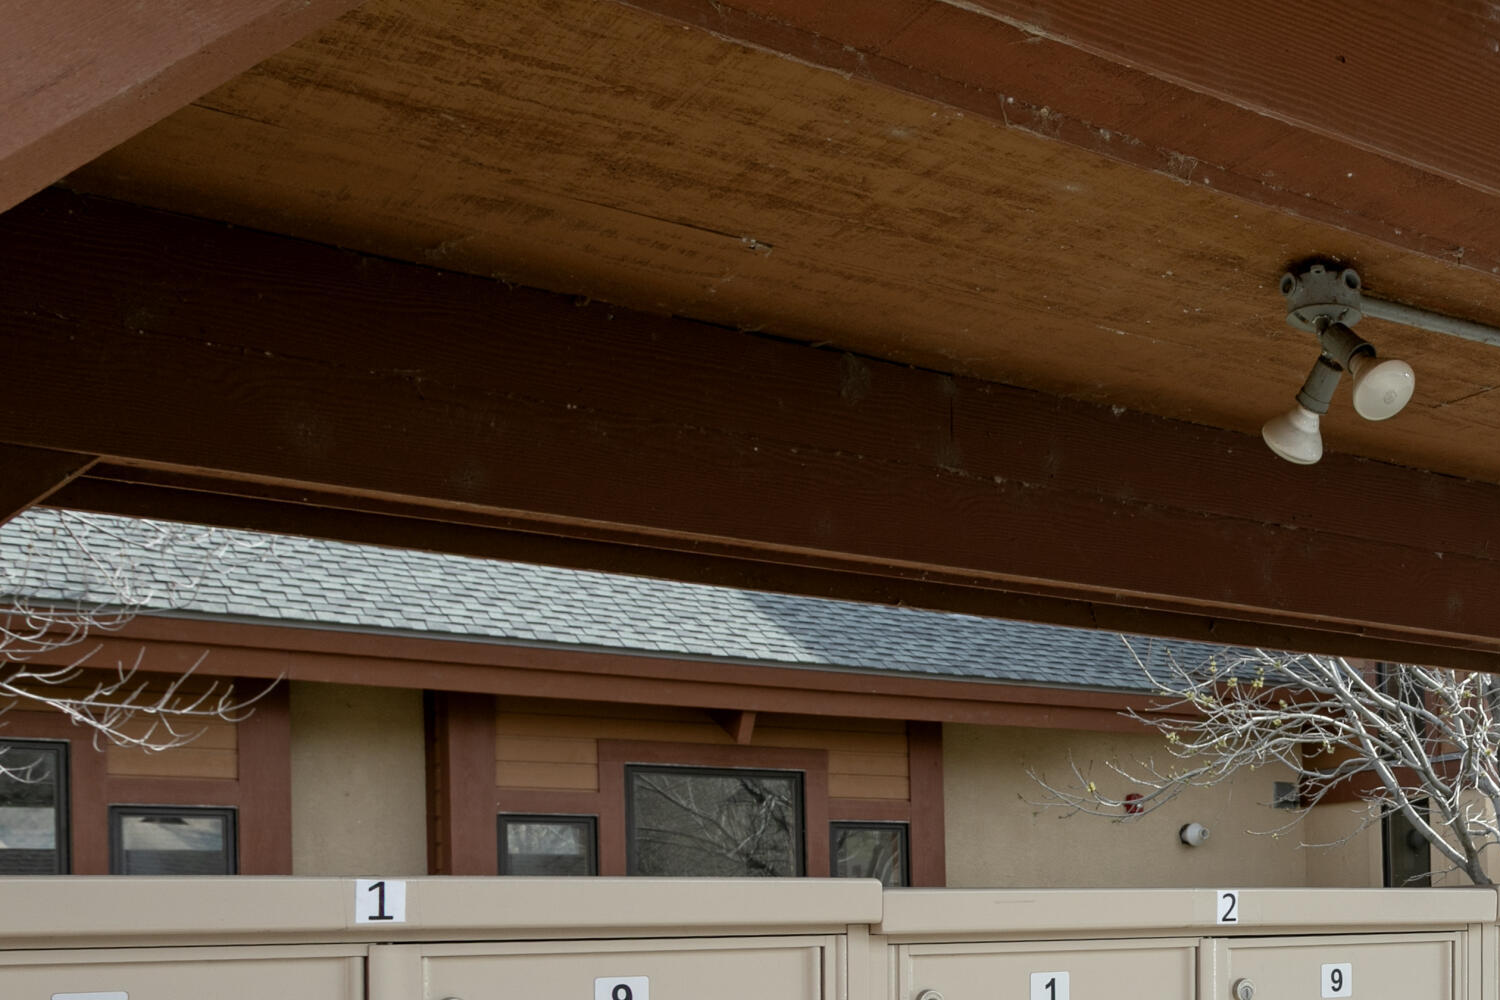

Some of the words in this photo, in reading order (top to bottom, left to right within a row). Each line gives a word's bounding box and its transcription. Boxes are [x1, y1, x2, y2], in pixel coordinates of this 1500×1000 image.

[367, 880, 395, 922] 1
[1221, 893, 1237, 922] 2
[1330, 968, 1343, 992] 9
